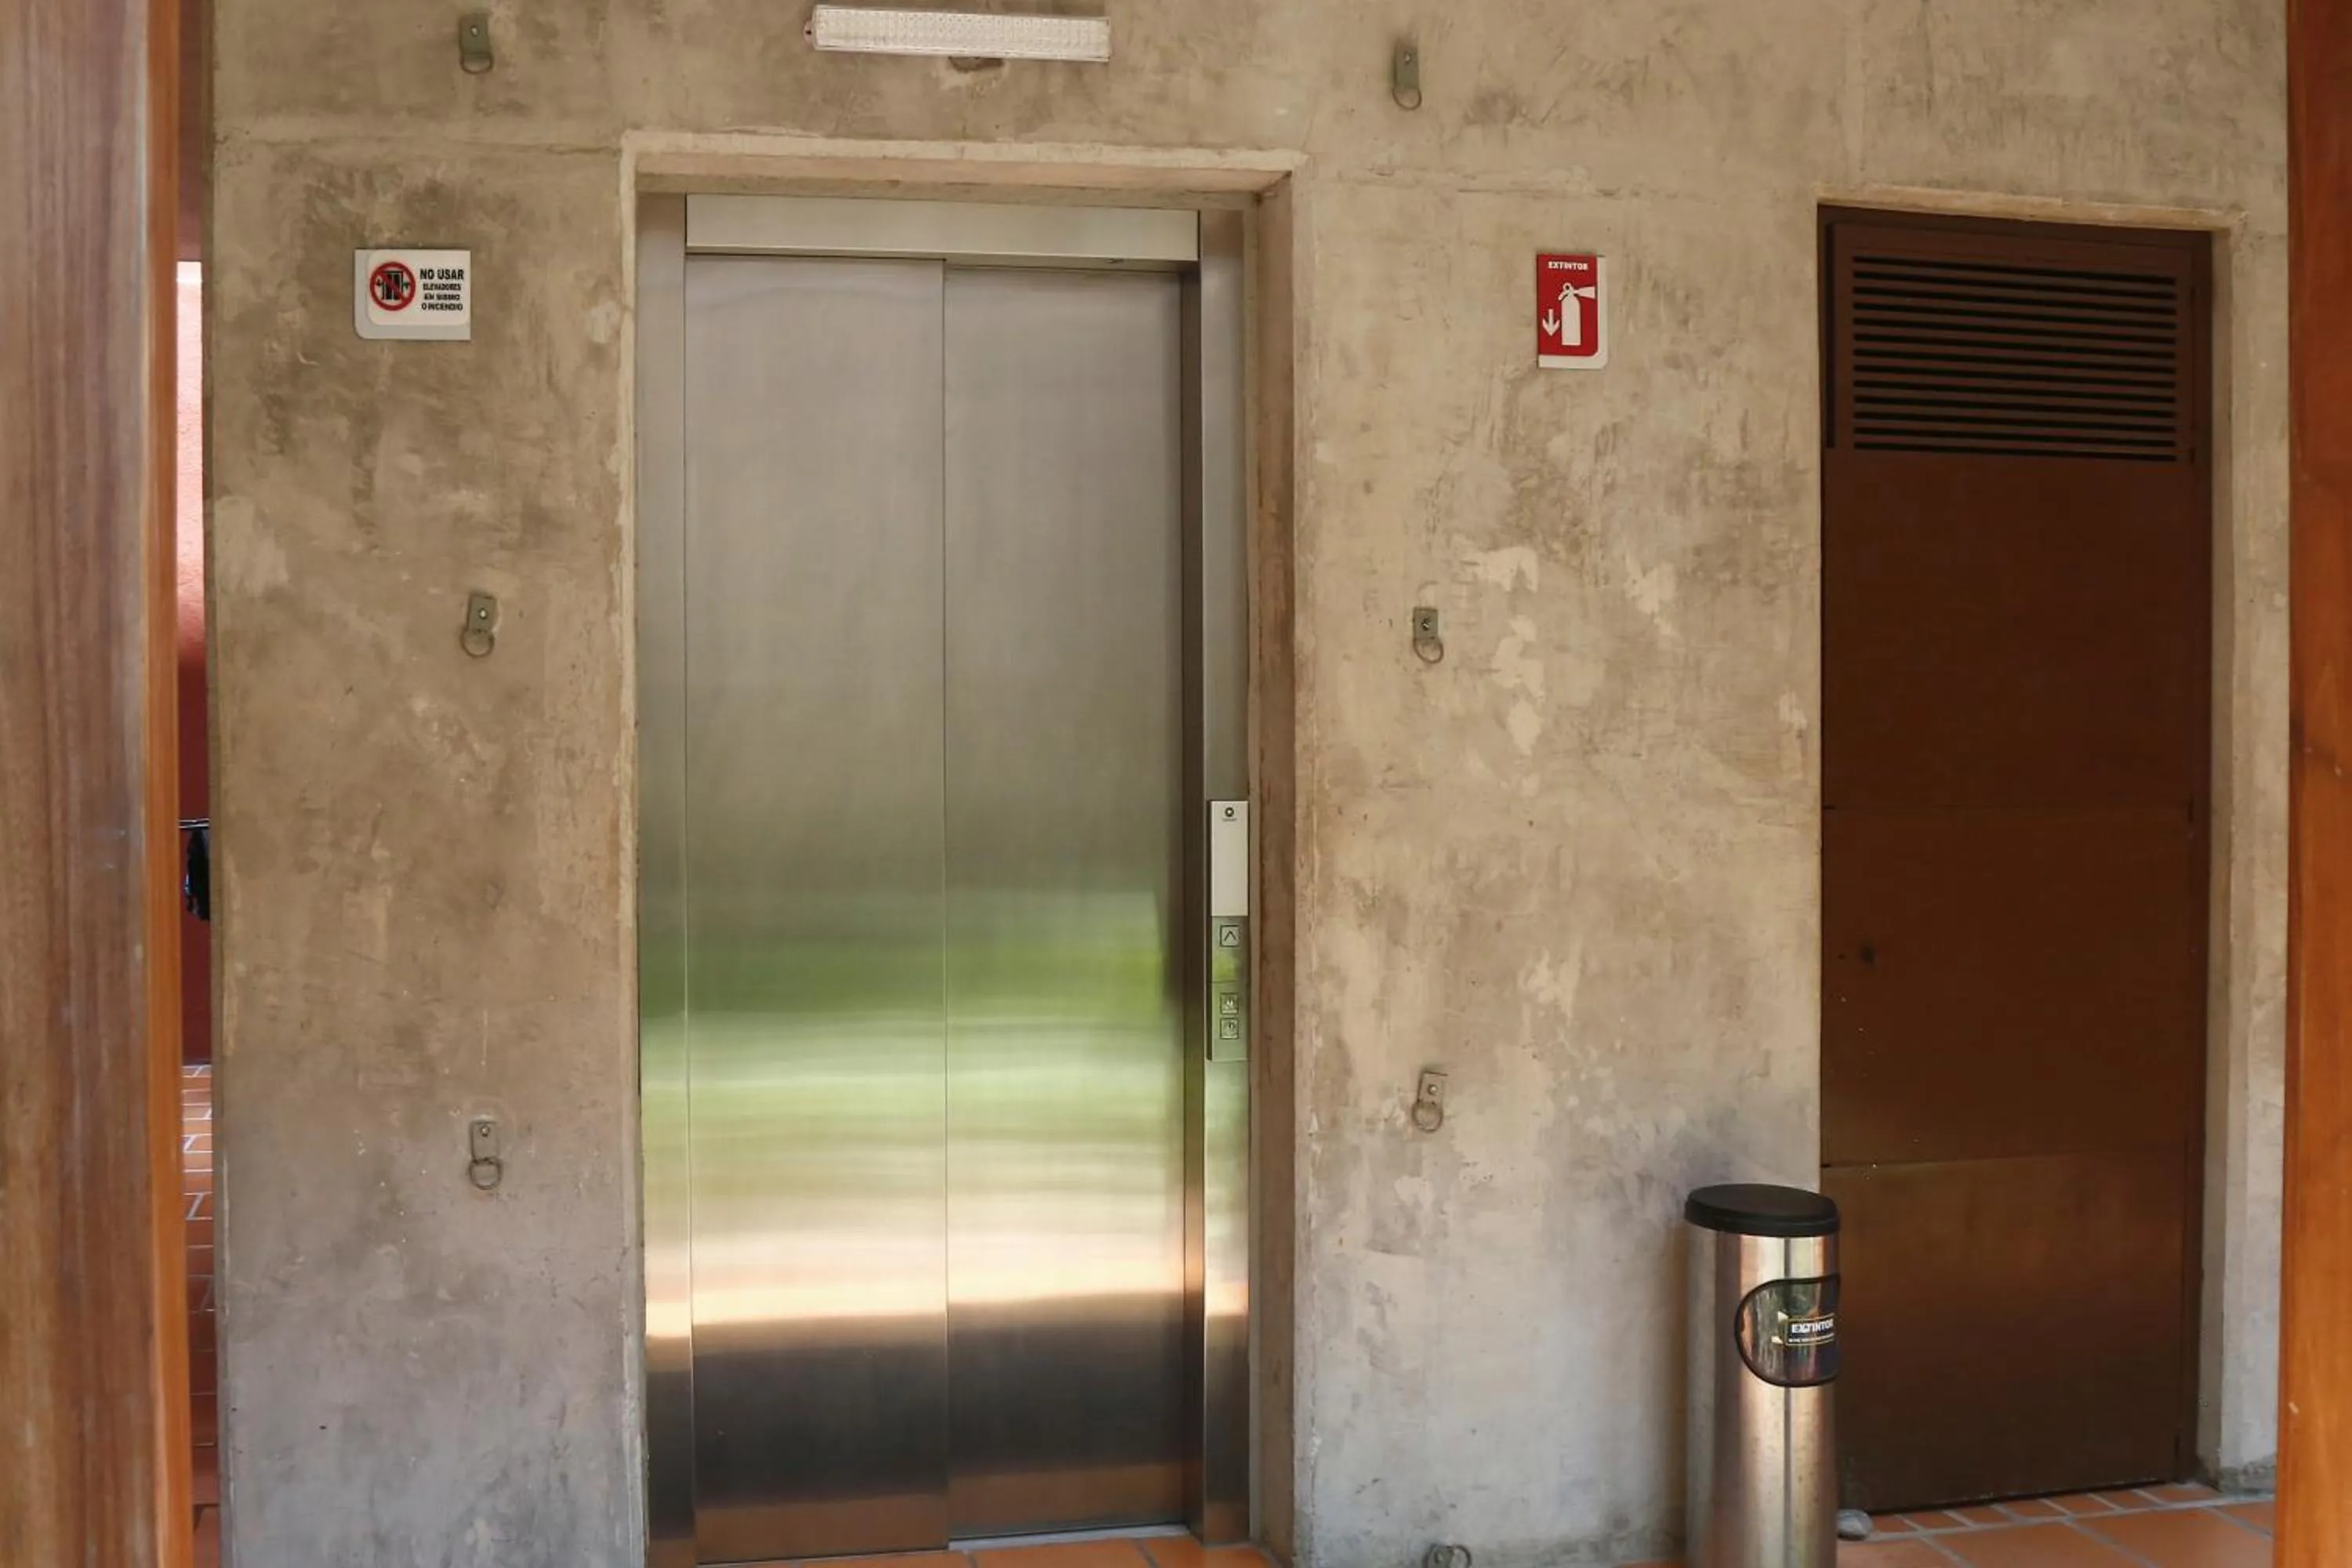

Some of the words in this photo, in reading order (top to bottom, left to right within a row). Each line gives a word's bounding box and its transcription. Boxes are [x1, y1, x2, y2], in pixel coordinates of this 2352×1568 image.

[1548, 261, 1588, 270] EXTINTOR
[419, 268, 434, 280] NO
[437, 268, 465, 280] USAR
[421, 302, 427, 310] O
[427, 303, 463, 311] INCENDIO
